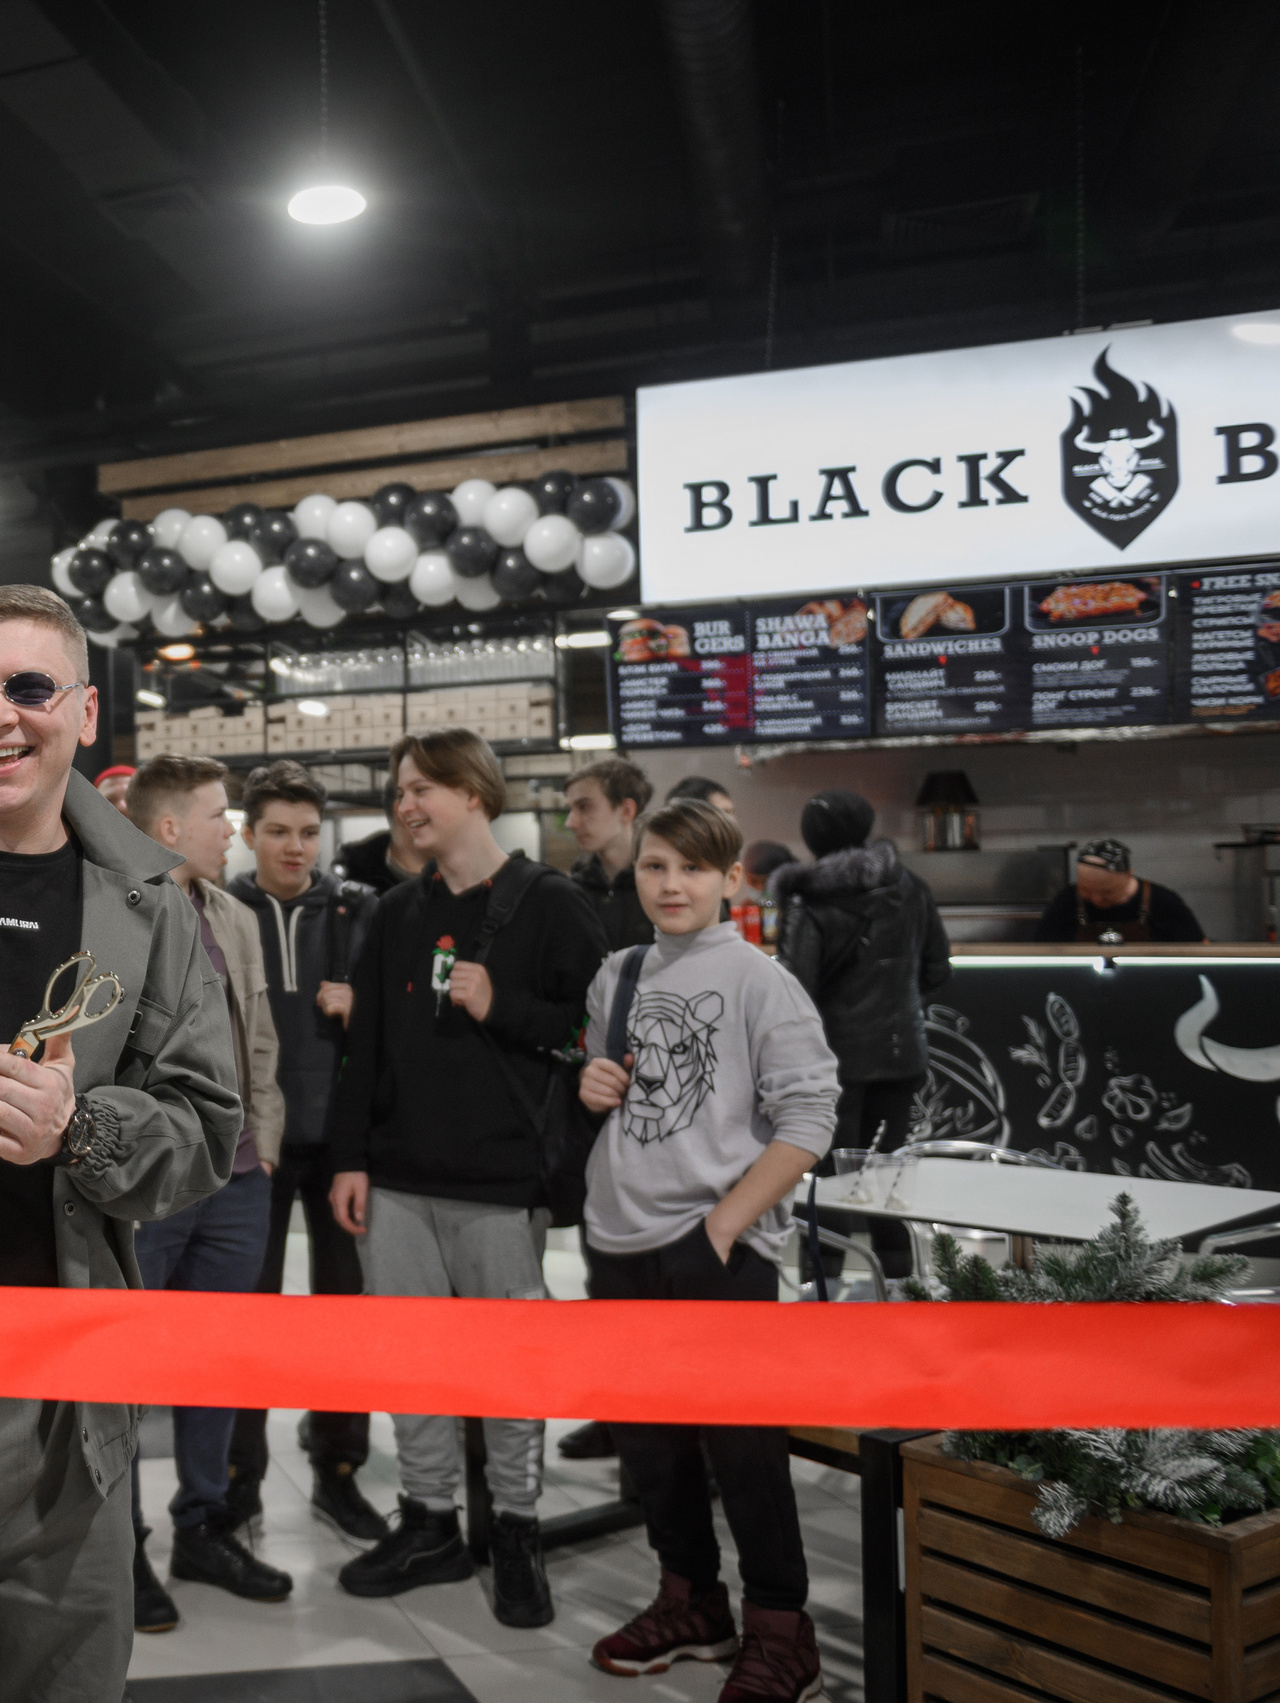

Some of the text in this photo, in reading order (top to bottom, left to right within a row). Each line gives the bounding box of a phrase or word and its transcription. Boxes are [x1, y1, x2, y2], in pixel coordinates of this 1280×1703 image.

[683, 422, 1279, 533] BLACK B
[694, 621, 731, 638] BUR
[756, 614, 827, 633] SHAWA
[695, 636, 744, 654] GERS
[757, 630, 829, 649] BANGA
[1032, 627, 1158, 649] SNOOP DOGS
[884, 638, 1001, 658] SANDWICHES
